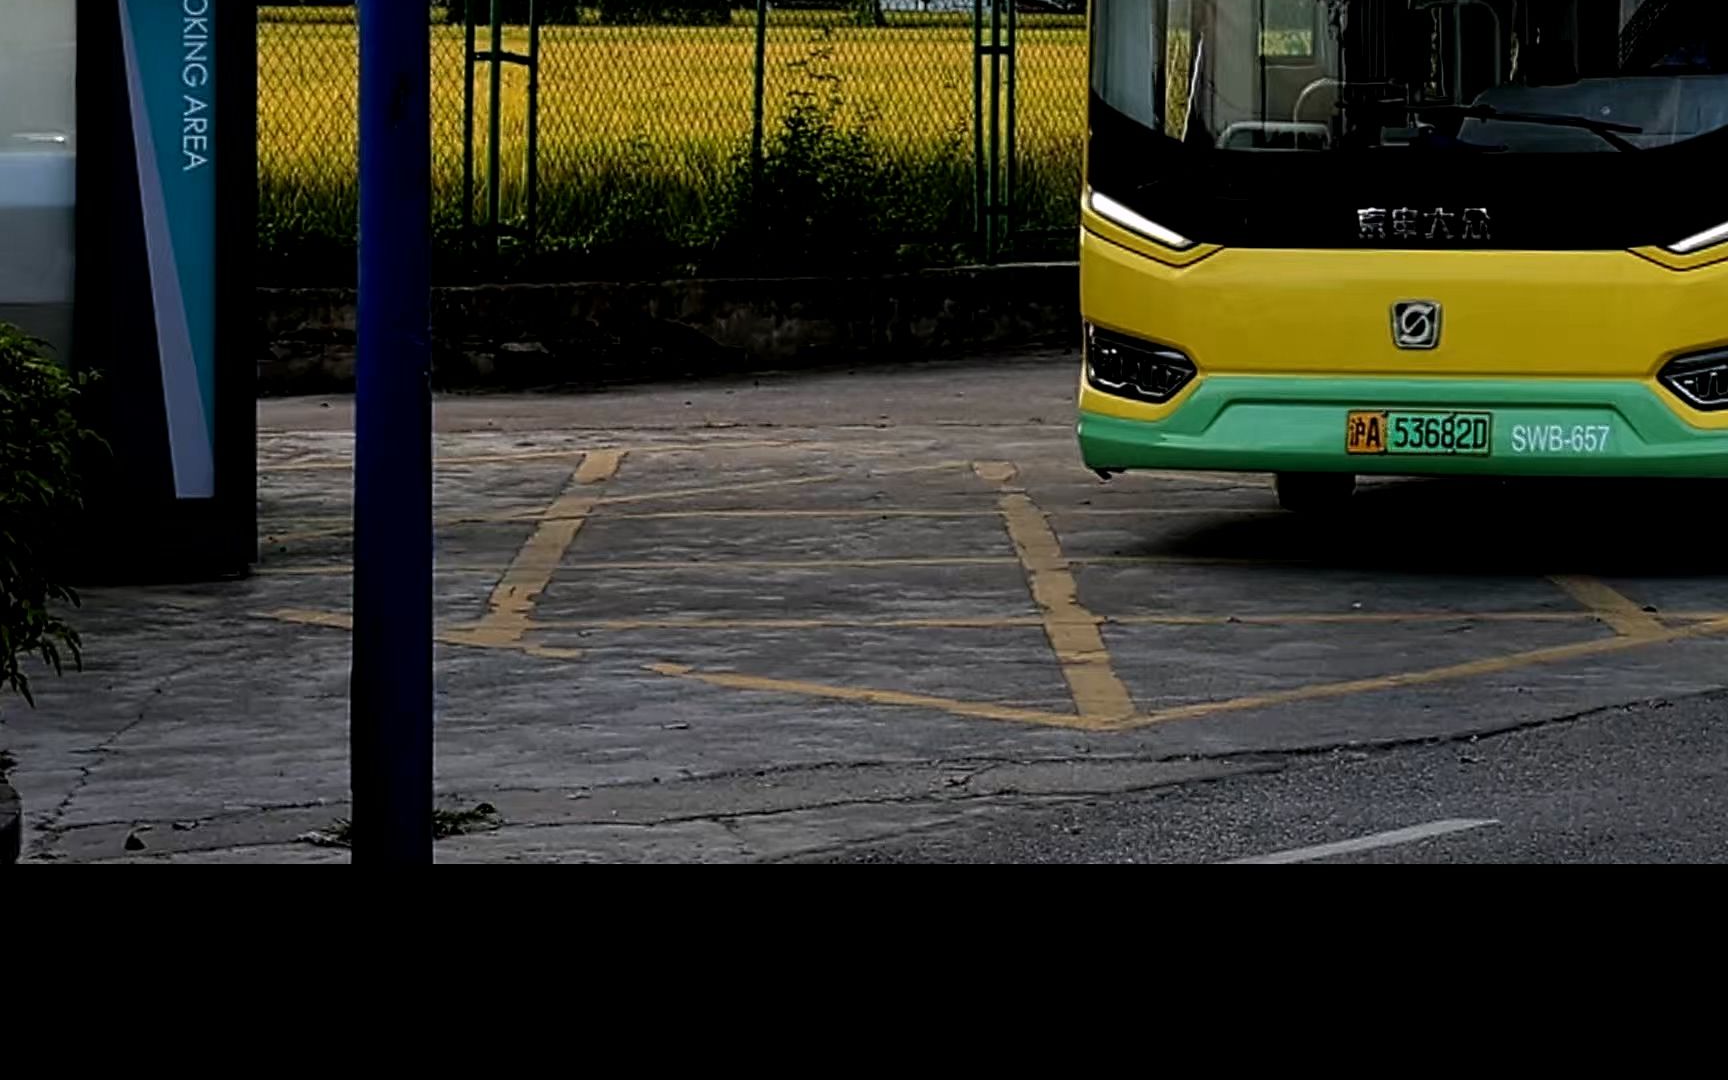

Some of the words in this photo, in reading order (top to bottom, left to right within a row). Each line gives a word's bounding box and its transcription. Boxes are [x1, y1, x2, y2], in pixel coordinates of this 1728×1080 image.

[182, 94, 209, 171] AREA
[1394, 417, 1488, 450] 53682D
[1511, 424, 1610, 452] SWB-657
